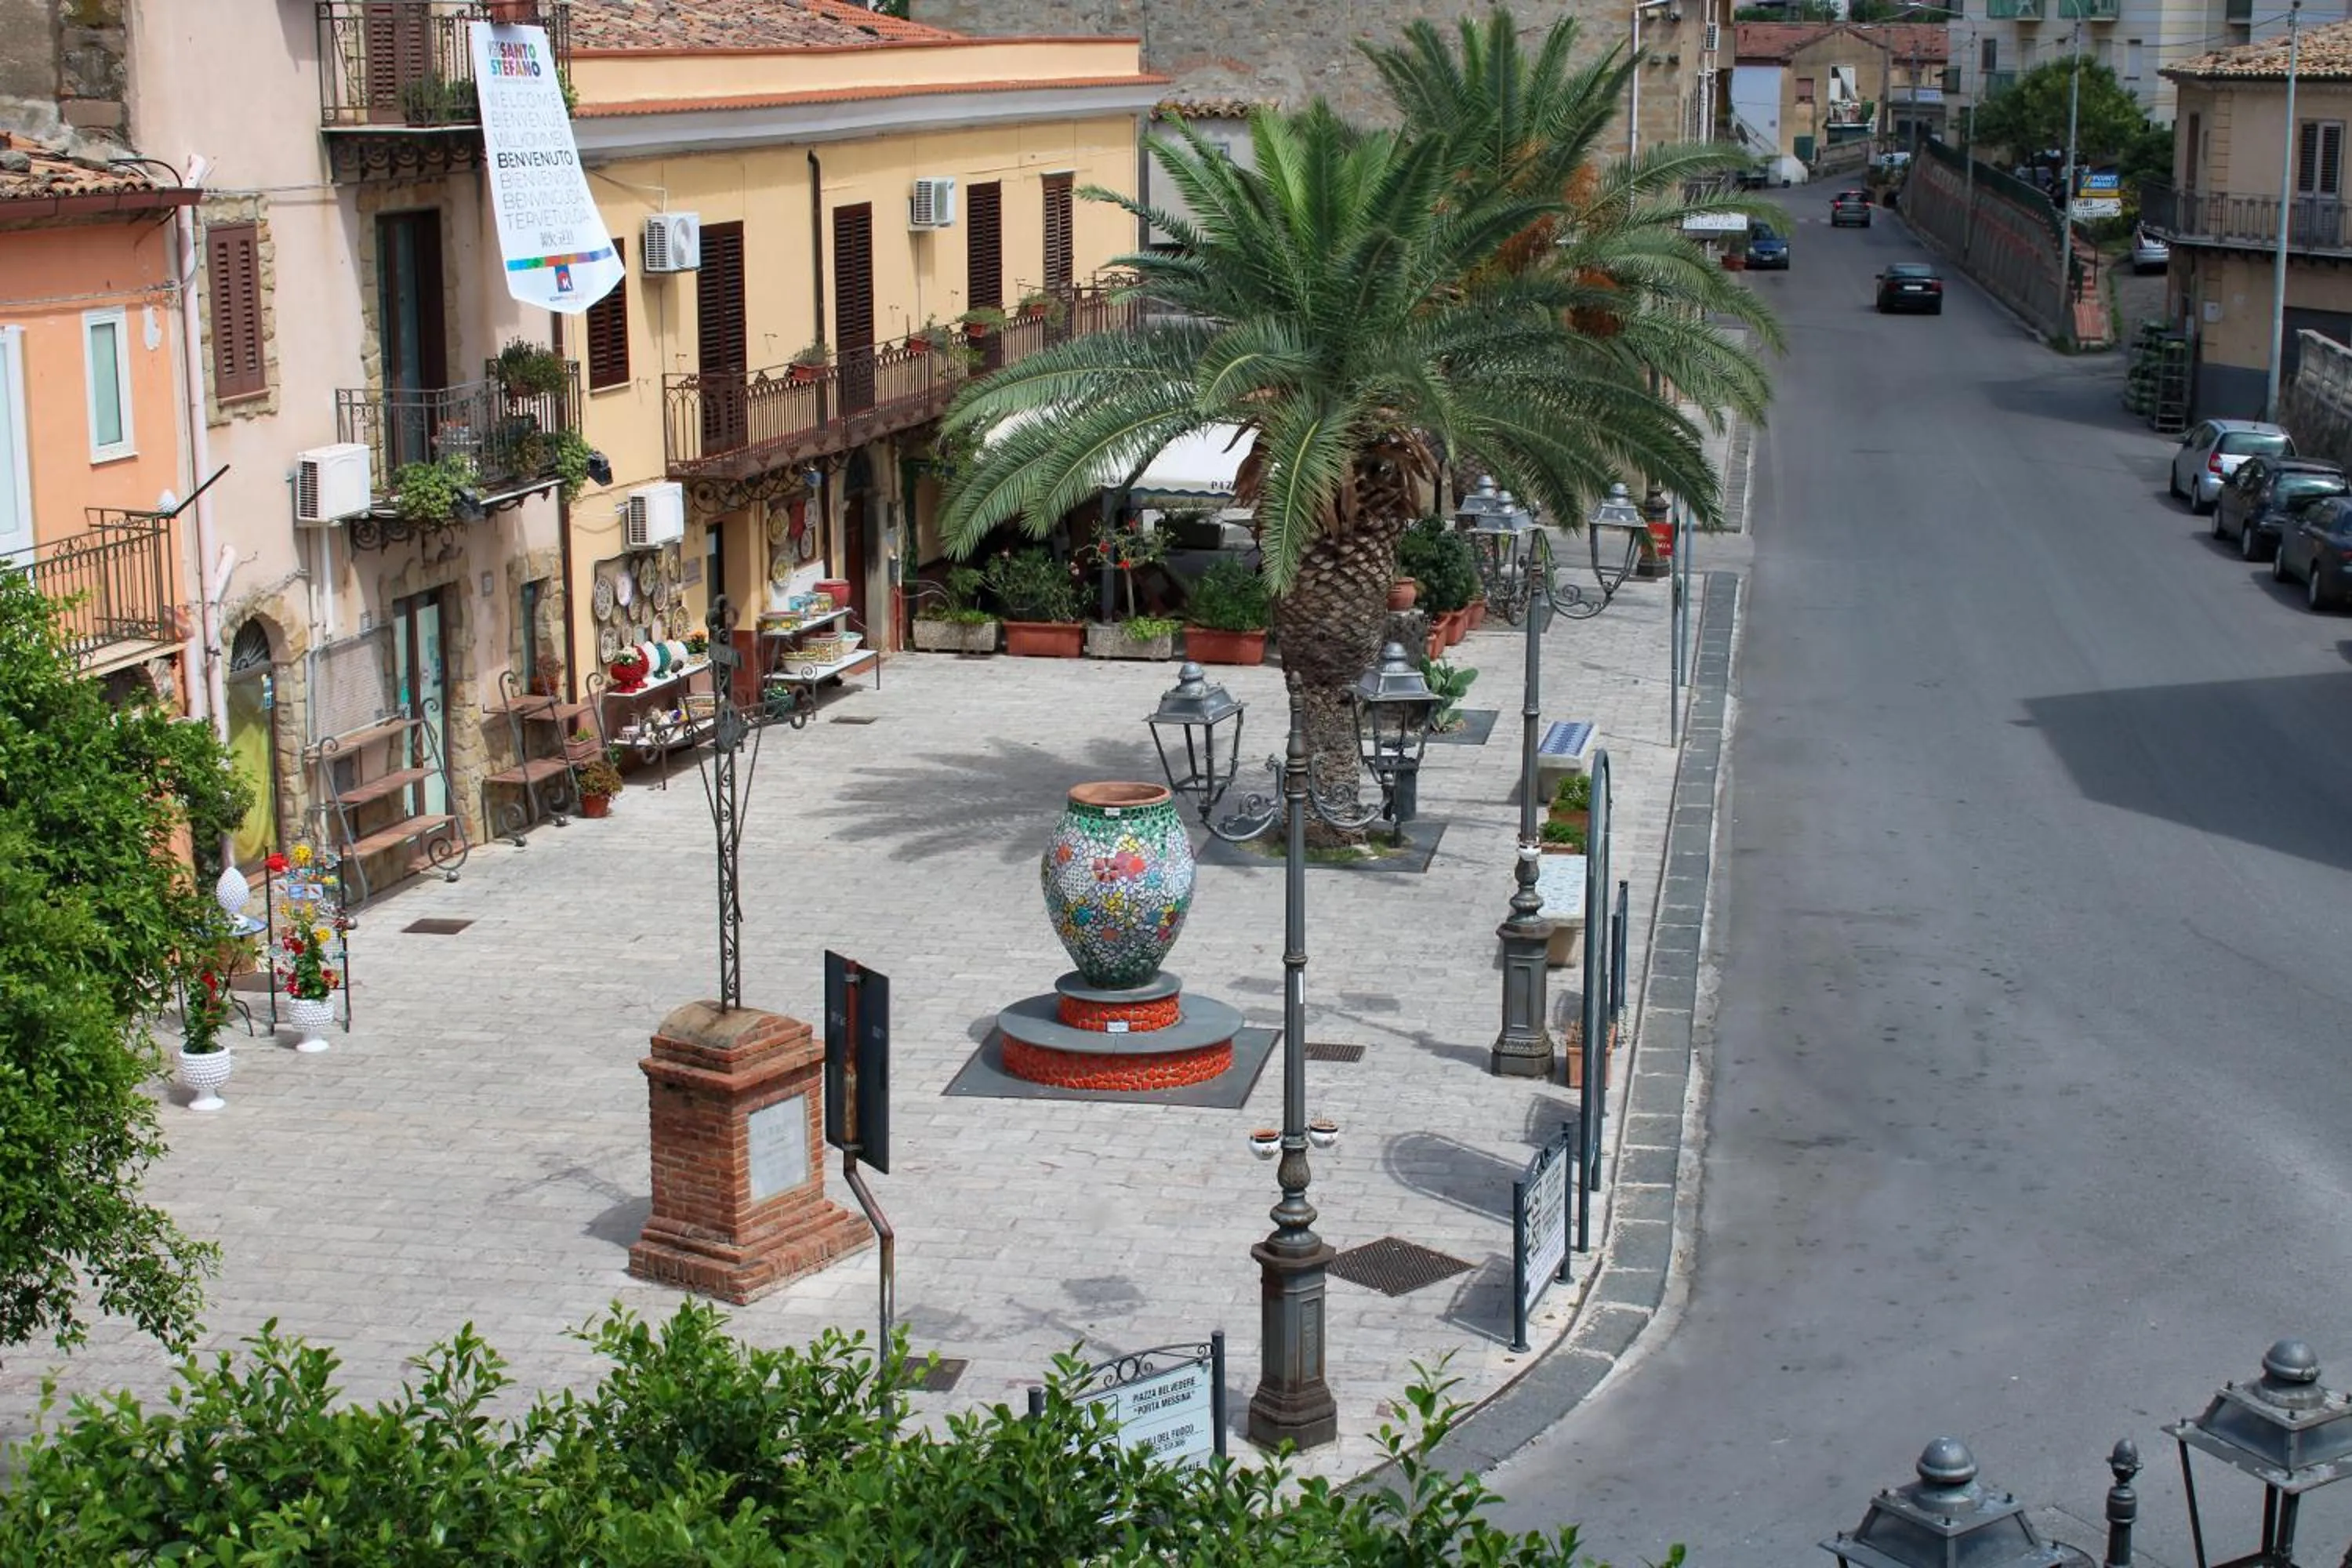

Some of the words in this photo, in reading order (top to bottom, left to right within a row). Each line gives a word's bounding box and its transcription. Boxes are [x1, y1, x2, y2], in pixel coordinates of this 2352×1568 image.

[499, 41, 536, 59] SANTO
[490, 59, 541, 77] STEFANO
[488, 90, 560, 109] WELCOME
[492, 111, 564, 128] BIENVENUE
[497, 151, 573, 169] BENVENUTO
[1133, 1388, 1156, 1403] PIAZZA
[1159, 1376, 1195, 1396] BELVEDERE
